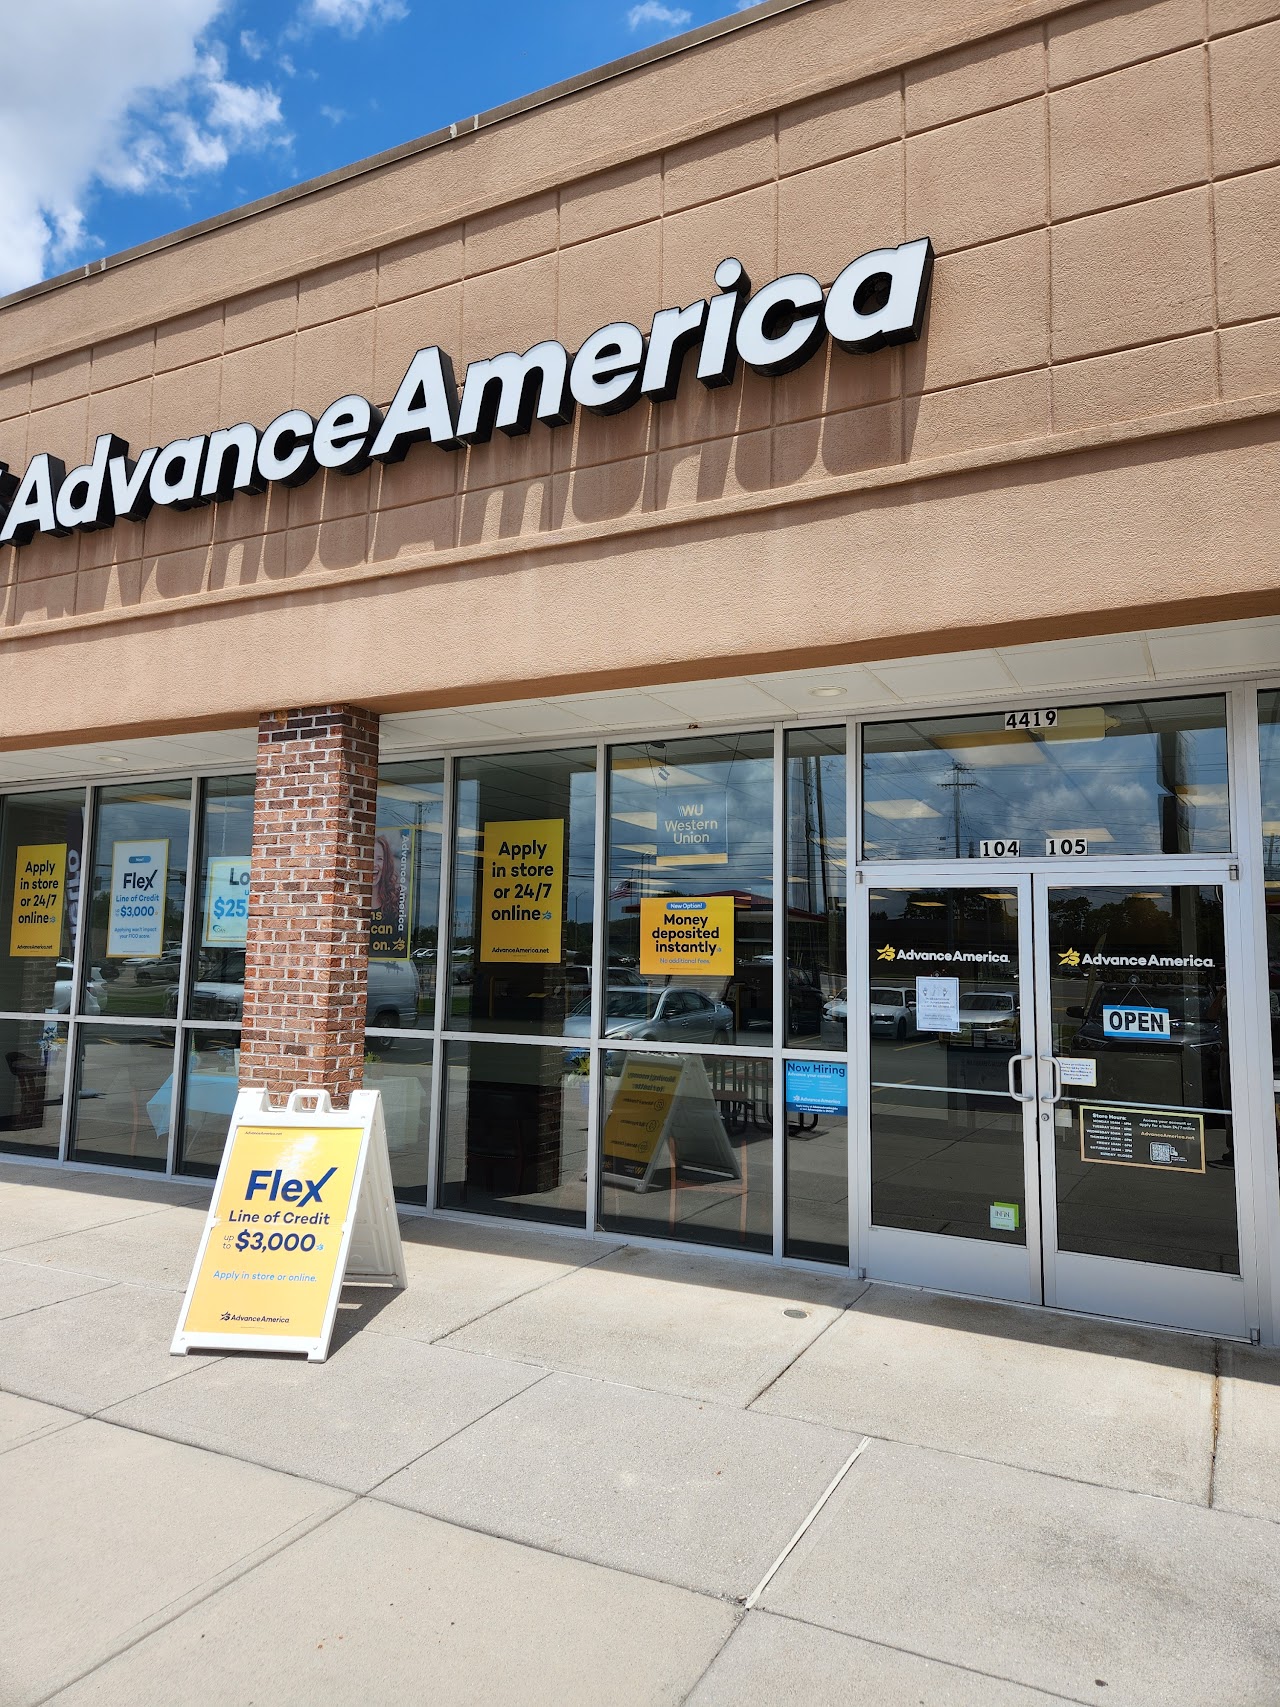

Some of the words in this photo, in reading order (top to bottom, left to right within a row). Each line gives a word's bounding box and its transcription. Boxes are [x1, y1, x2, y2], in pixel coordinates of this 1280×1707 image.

[1006, 710, 1057, 728] 4419
[678, 804, 703, 817] WU
[664, 820, 718, 833] Western
[673, 831, 710, 844] Union
[498, 839, 547, 860] Apply
[983, 841, 1018, 857] 104
[1048, 838, 1086, 855] 105
[25, 860, 55, 876] Apply
[492, 862, 506, 877] in
[511, 862, 554, 877] store
[20, 878, 29, 890] in
[32, 880, 58, 890] store
[123, 869, 158, 891] Flex
[229, 868, 250, 886] Lo
[115, 894, 129, 902] Line
[130, 894, 138, 902] of
[138, 894, 159, 902] Credit
[493, 887, 510, 899] or
[514, 882, 552, 901] 24/7
[20, 898, 31, 907] or
[33, 894, 57, 908] 24/7
[213, 896, 249, 920] $25,
[682, 902, 703, 910] Option!
[18, 911, 49, 924] online
[120, 905, 155, 918] $3,000
[491, 905, 541, 921] online
[370, 924, 393, 934] can
[664, 914, 708, 929] Money
[652, 926, 719, 942] deposited
[372, 941, 391, 950] on.
[655, 940, 717, 956] instantly
[1109, 1011, 1165, 1032] OPEN
[787, 1063, 810, 1072] Now
[813, 1064, 845, 1078] Hiring
[244, 1167, 339, 1207] Flex
[228, 1209, 260, 1222] Line
[263, 1210, 281, 1223] of
[283, 1211, 330, 1225] Credit
[223, 1234, 234, 1242] up
[235, 1229, 316, 1253] $3,000
[213, 1270, 239, 1280] Apply
[241, 1271, 250, 1280] in
[252, 1273, 275, 1281] store
[288, 1273, 317, 1282] online.
[231, 1314, 290, 1324] AdvanceAmerica
